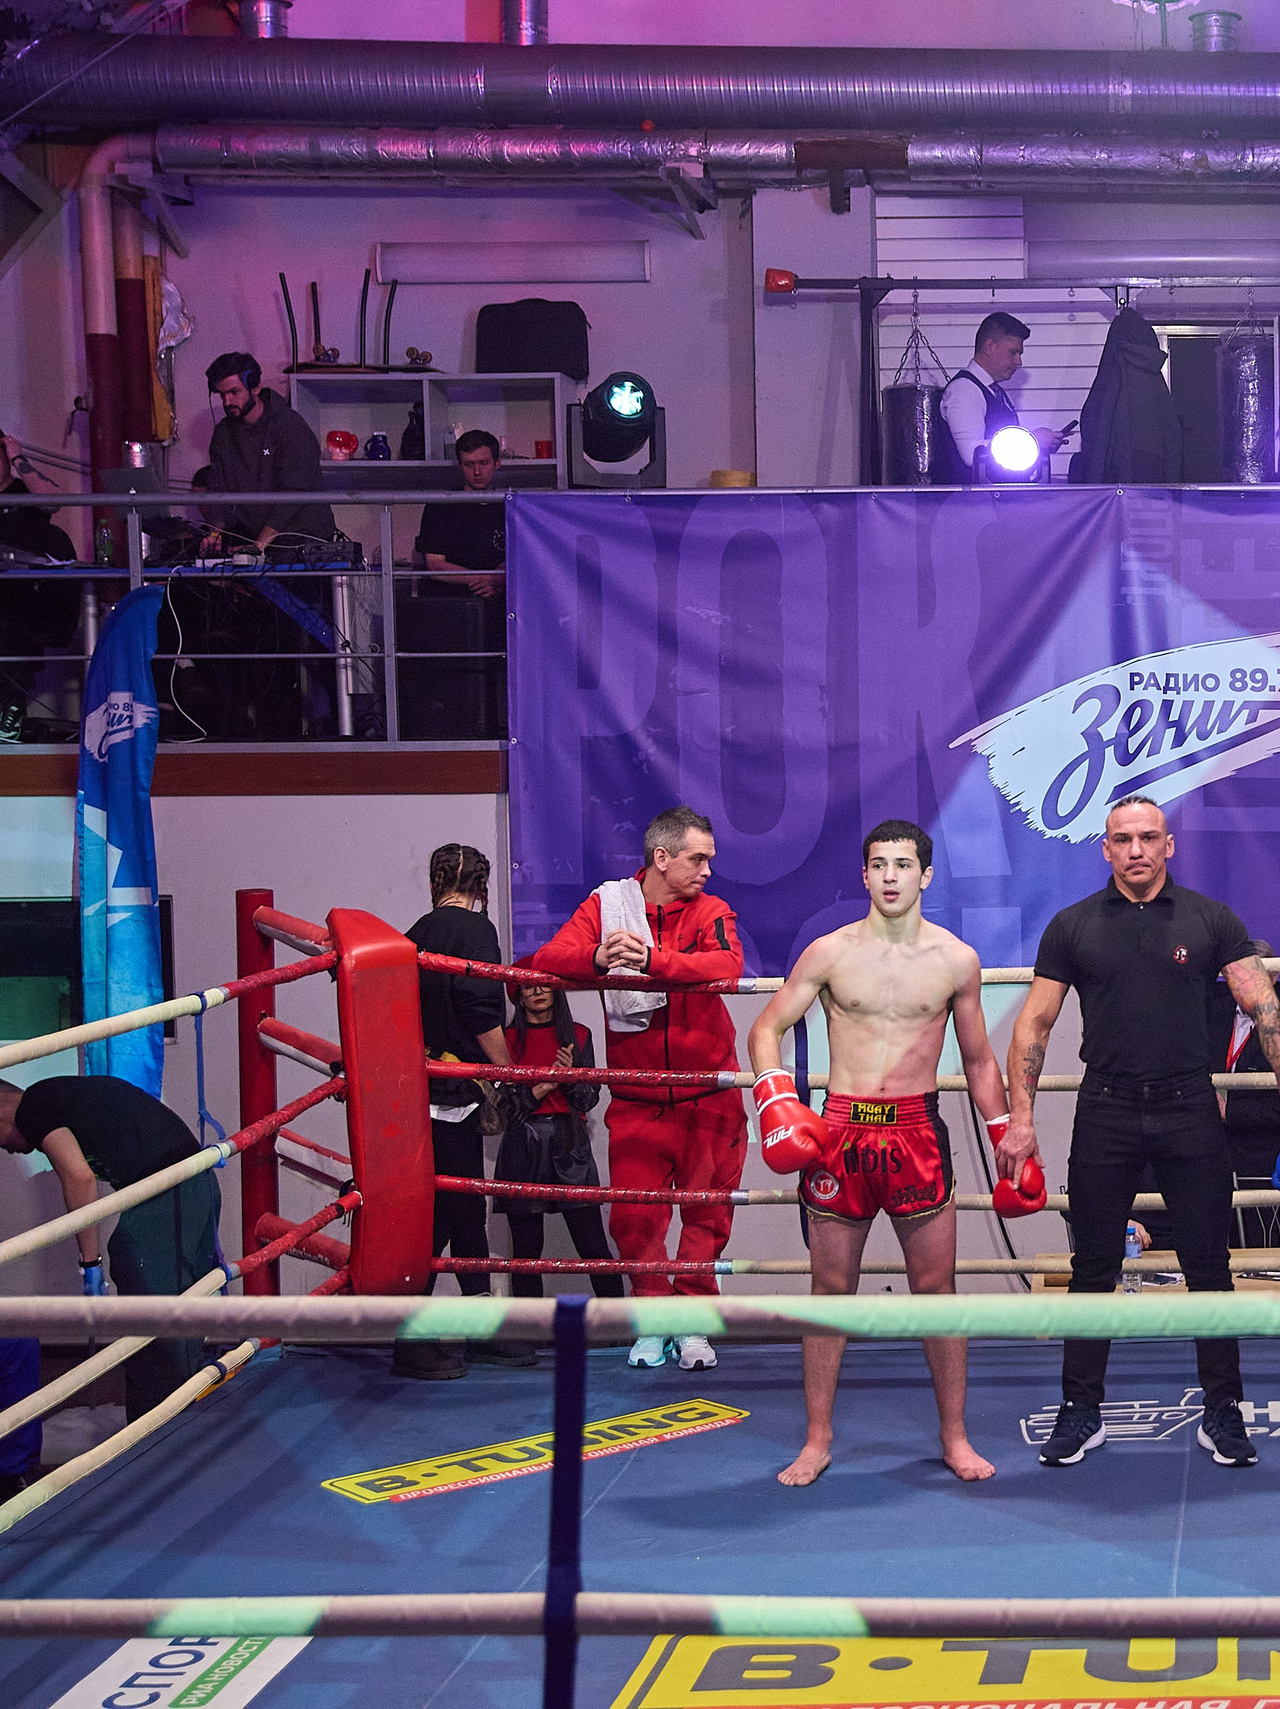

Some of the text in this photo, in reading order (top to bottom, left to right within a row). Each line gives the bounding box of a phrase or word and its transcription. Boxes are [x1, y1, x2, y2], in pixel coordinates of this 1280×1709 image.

[1129, 671, 1221, 695] РАДИО
[858, 1103, 891, 1114] MUAY
[858, 1113, 888, 1124] THAI
[663, 1418, 736, 1440] КОМАНДА
